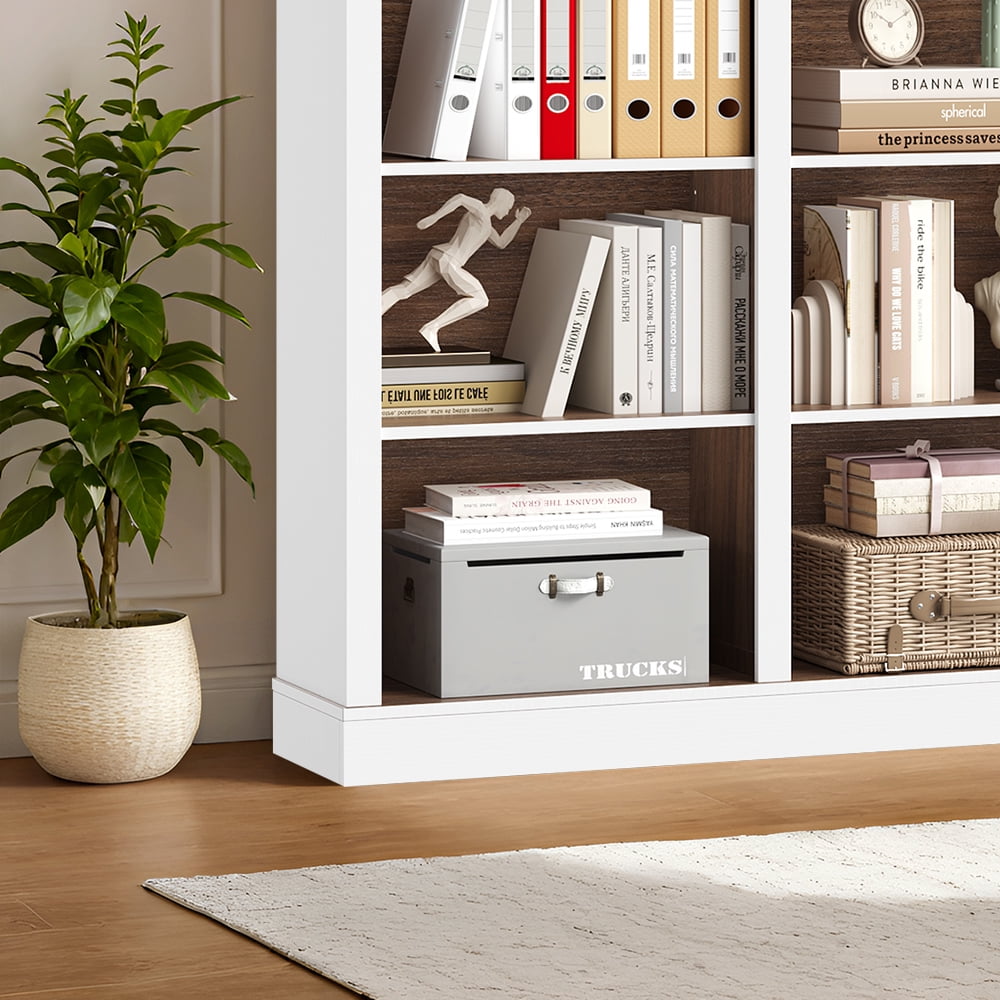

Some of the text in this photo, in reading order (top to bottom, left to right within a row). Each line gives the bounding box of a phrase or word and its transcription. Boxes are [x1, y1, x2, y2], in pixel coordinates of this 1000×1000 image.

[892, 78, 964, 90] BRIANNA
[940, 103, 986, 121] spherical
[917, 219, 925, 241] ride
[917, 244, 925, 263] the
[620, 246, 630, 323] ДАНТЕ АЛИГЬЕРИ
[917, 266, 925, 290] bike
[670, 269, 678, 345] МАТЕМАТИЧЕСКОГО
[891, 267, 902, 351] WHY DO WE LOVE CATS
[559, 288, 591, 375] К ВЕЧНОМУ МИРУ
[735, 298, 746, 344] РАССКАЖИ
[735, 346, 746, 364] МНЕ
[735, 375, 746, 398] МОРЕ
[511, 496, 637, 508] GOING AGAINST THE GRAIN
[580, 659, 682, 680] TRUCKS
